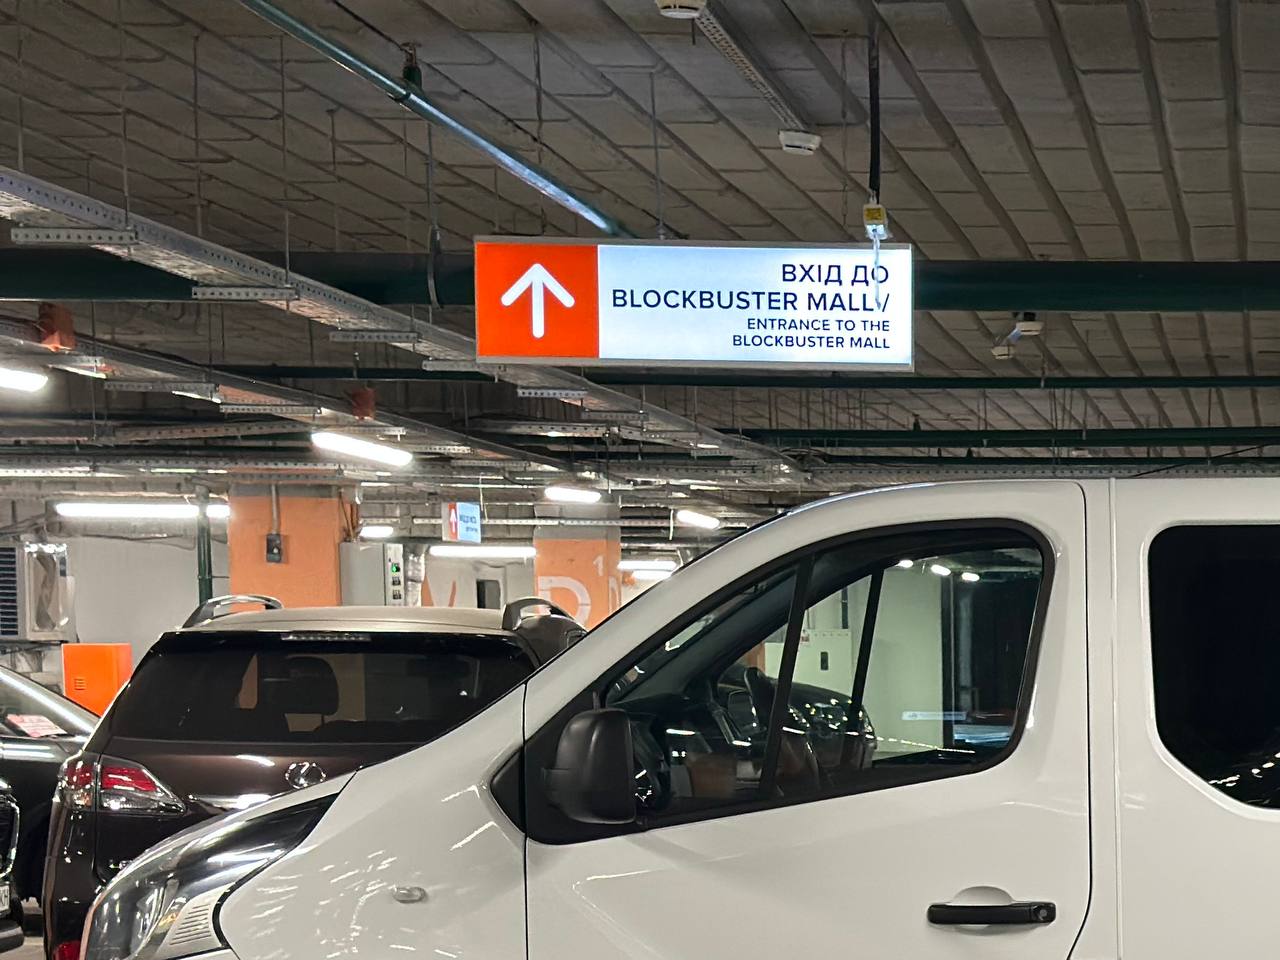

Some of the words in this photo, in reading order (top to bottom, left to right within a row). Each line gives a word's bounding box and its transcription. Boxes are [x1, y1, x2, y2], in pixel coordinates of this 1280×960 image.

[782, 264, 843, 286] ВХІД
[851, 265, 889, 287] ДО
[612, 289, 798, 311] BLOCKBUSTER
[807, 293, 874, 311] MALL
[747, 318, 830, 331] ENTRANCE
[836, 320, 856, 331] TO
[861, 320, 890, 332] THE
[732, 335, 845, 348] BLOCKBUSTER
[850, 337, 890, 348] MALL
